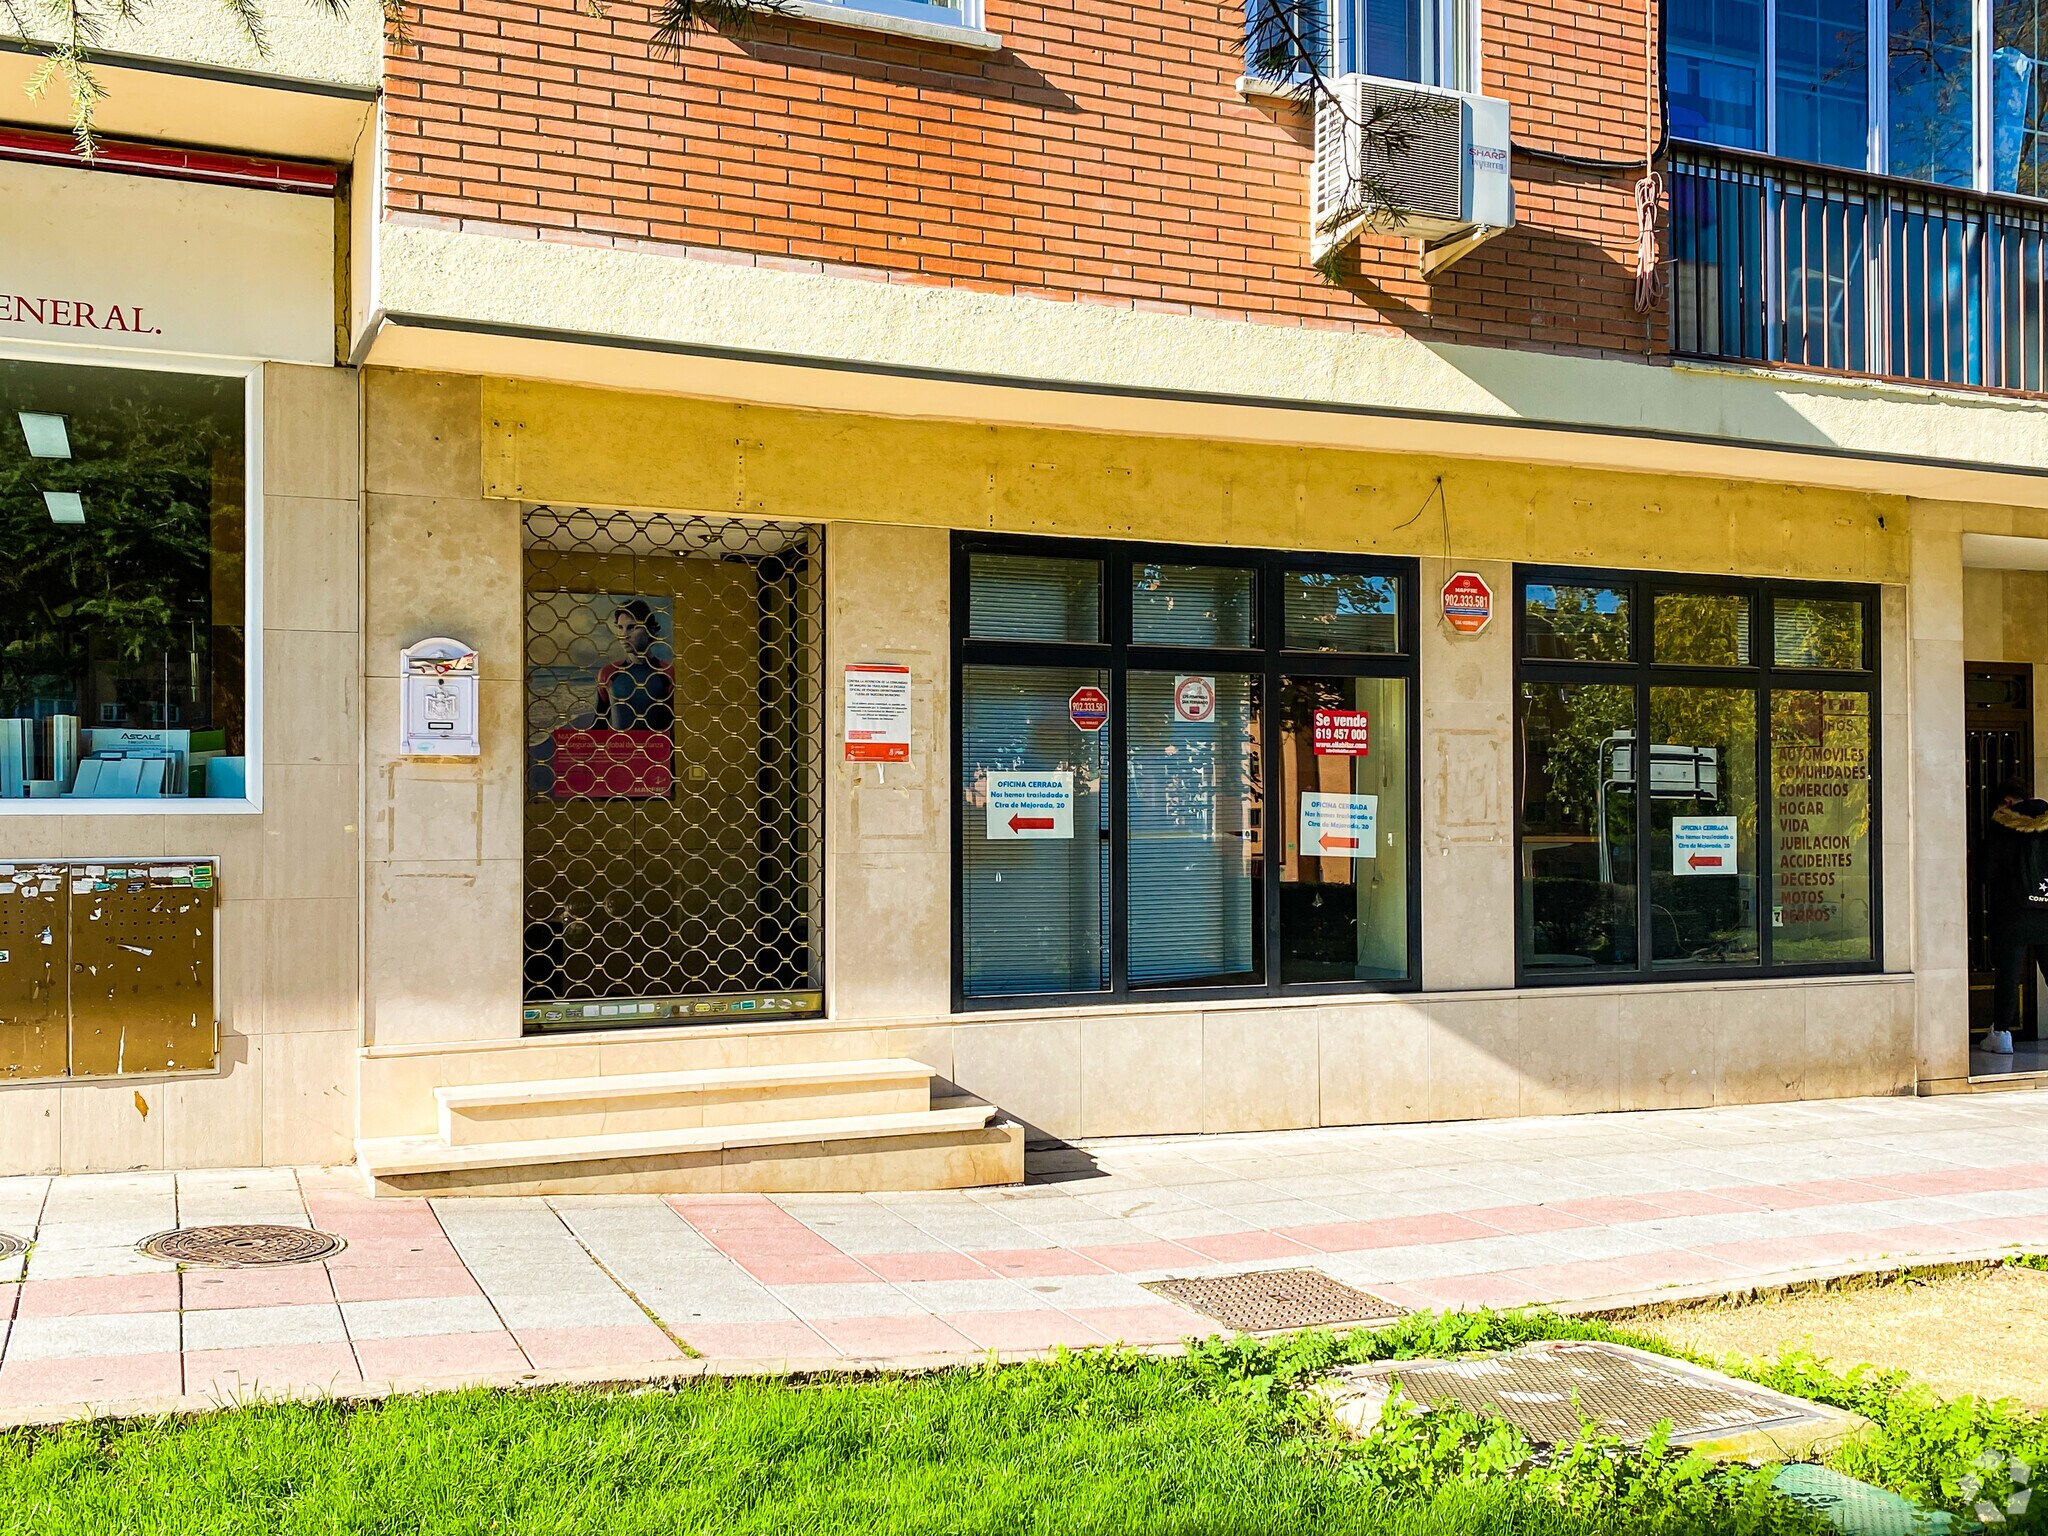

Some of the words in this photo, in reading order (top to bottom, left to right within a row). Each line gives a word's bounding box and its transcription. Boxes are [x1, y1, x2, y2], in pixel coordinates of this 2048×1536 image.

[1468, 147, 1506, 160] SHARP
[1315, 712, 1331, 726] Se
[1333, 714, 1367, 728] vende
[1315, 728, 1332, 739] 619
[1333, 728, 1350, 740] 457
[1351, 729, 1367, 740] 000
[1779, 748, 1865, 762] AUTOMOVILES
[1779, 765, 1866, 780] COMUNIDADES
[1026, 791, 1064, 799] trasladado
[1780, 783, 1849, 797] COMERCIOS
[994, 801, 1009, 809] Ctra
[1010, 801, 1019, 809] de
[1020, 801, 1055, 810] Mejorada,
[1311, 801, 1337, 809] OFICINA
[1779, 801, 1824, 815] HOGAR
[1780, 818, 1810, 832] VIDA
[1780, 836, 1850, 850] JUBILACION
[1780, 853, 1852, 868] ACCIDENTES
[1780, 872, 1835, 886] DECESOS
[1780, 890, 1824, 904] MOTOS
[1782, 908, 1830, 923] PERROS
